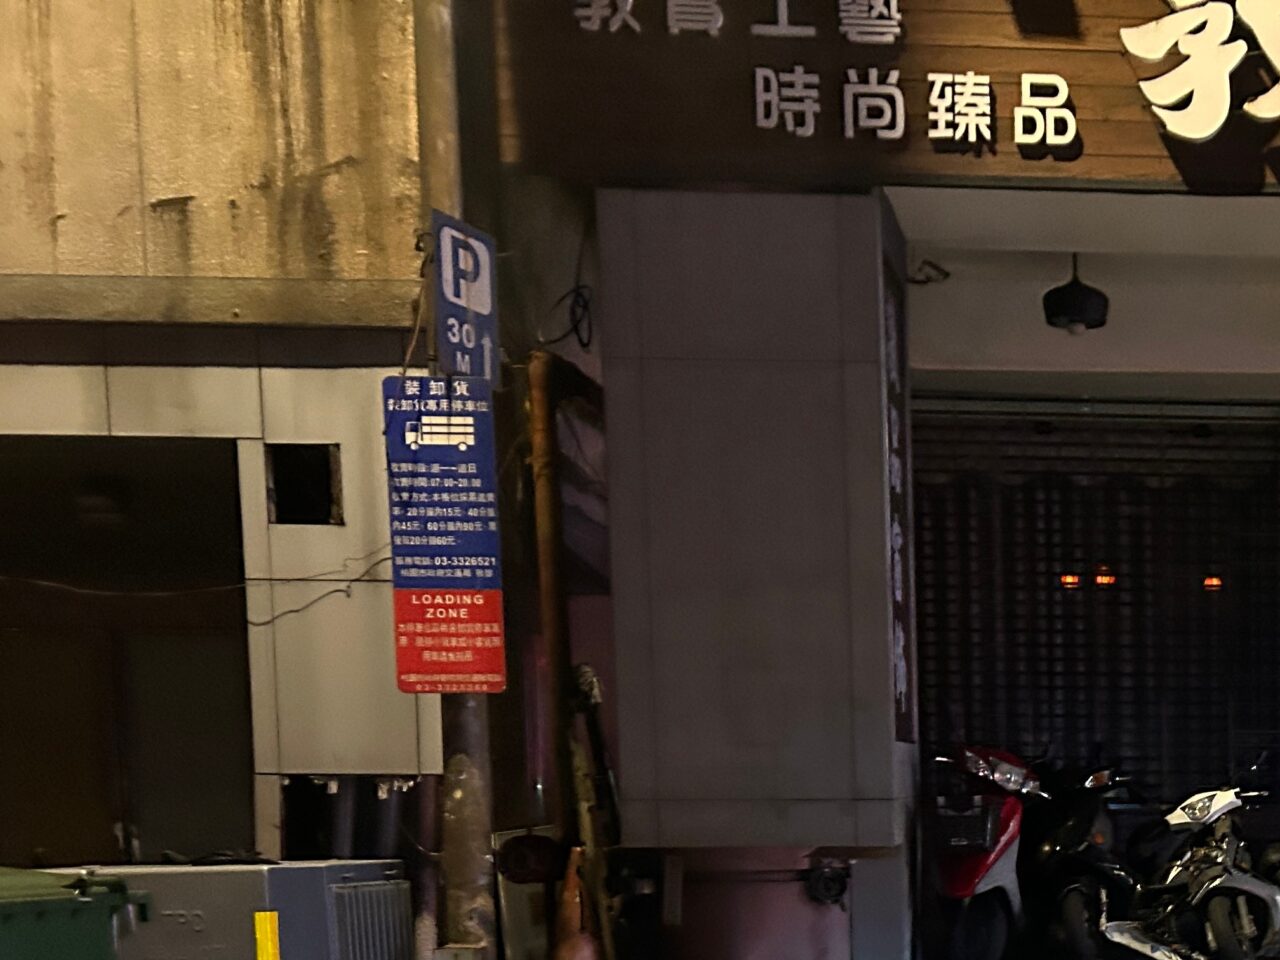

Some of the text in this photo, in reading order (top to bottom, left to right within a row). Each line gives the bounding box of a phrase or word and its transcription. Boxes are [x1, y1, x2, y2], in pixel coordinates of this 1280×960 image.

[754, 64, 1077, 147] 時尚臻品
[452, 236, 480, 299] P
[447, 318, 475, 348] 30
[412, 595, 484, 604] LOADING
[425, 608, 469, 618] ZONE
